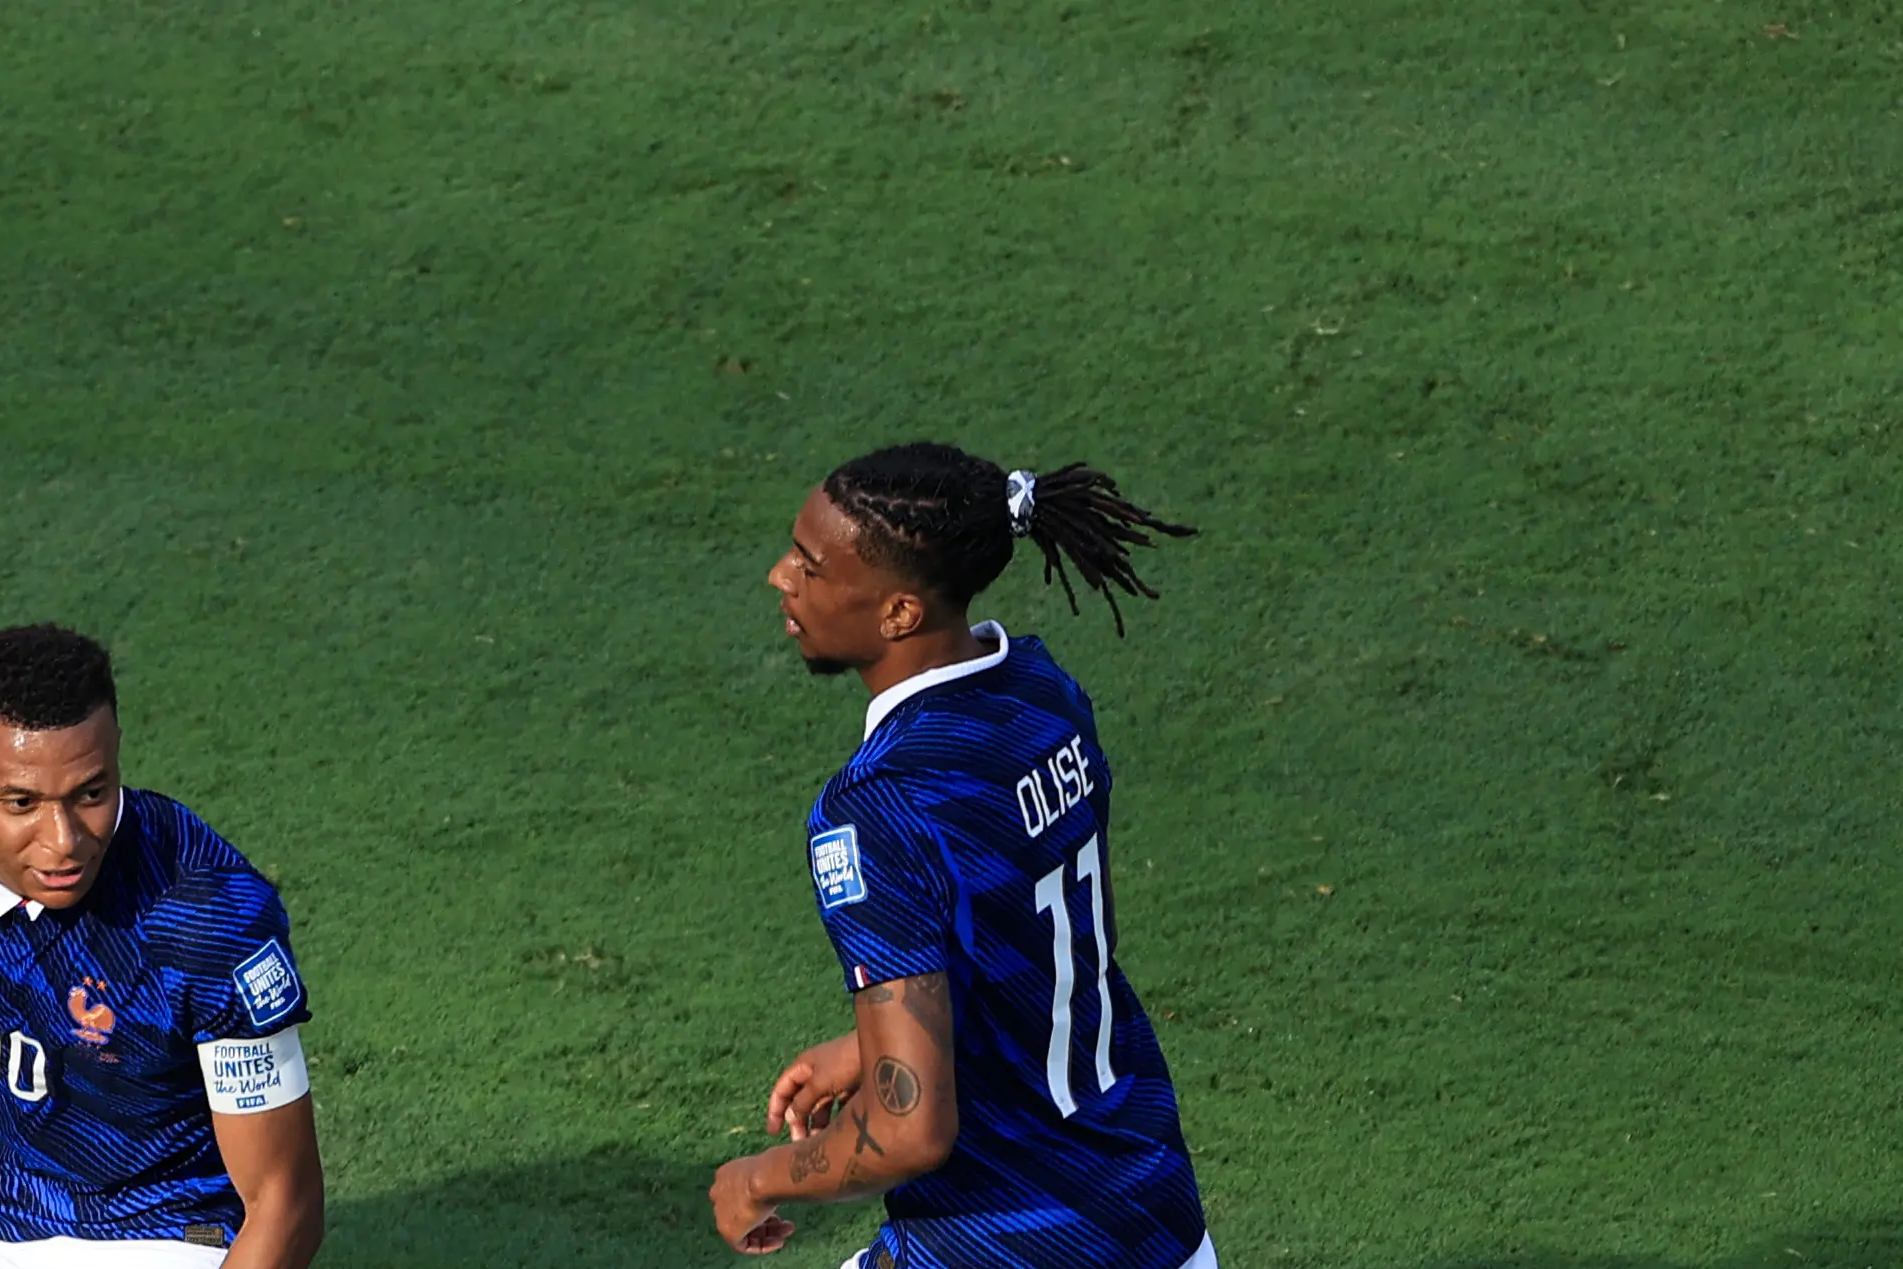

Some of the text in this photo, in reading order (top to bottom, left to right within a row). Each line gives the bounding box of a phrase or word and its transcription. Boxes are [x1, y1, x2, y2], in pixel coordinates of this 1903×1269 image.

[1016, 733, 1095, 838] OLISE
[816, 850, 849, 875] UNITES
[248, 961, 286, 996] UNITES
[268, 973, 292, 1001] World
[1035, 832, 1117, 1119] 11
[214, 1041, 273, 1059] FOOTBALL
[214, 1054, 275, 1078] UNITES
[213, 1070, 282, 1094] the World
[237, 1095, 266, 1109] FIFA
